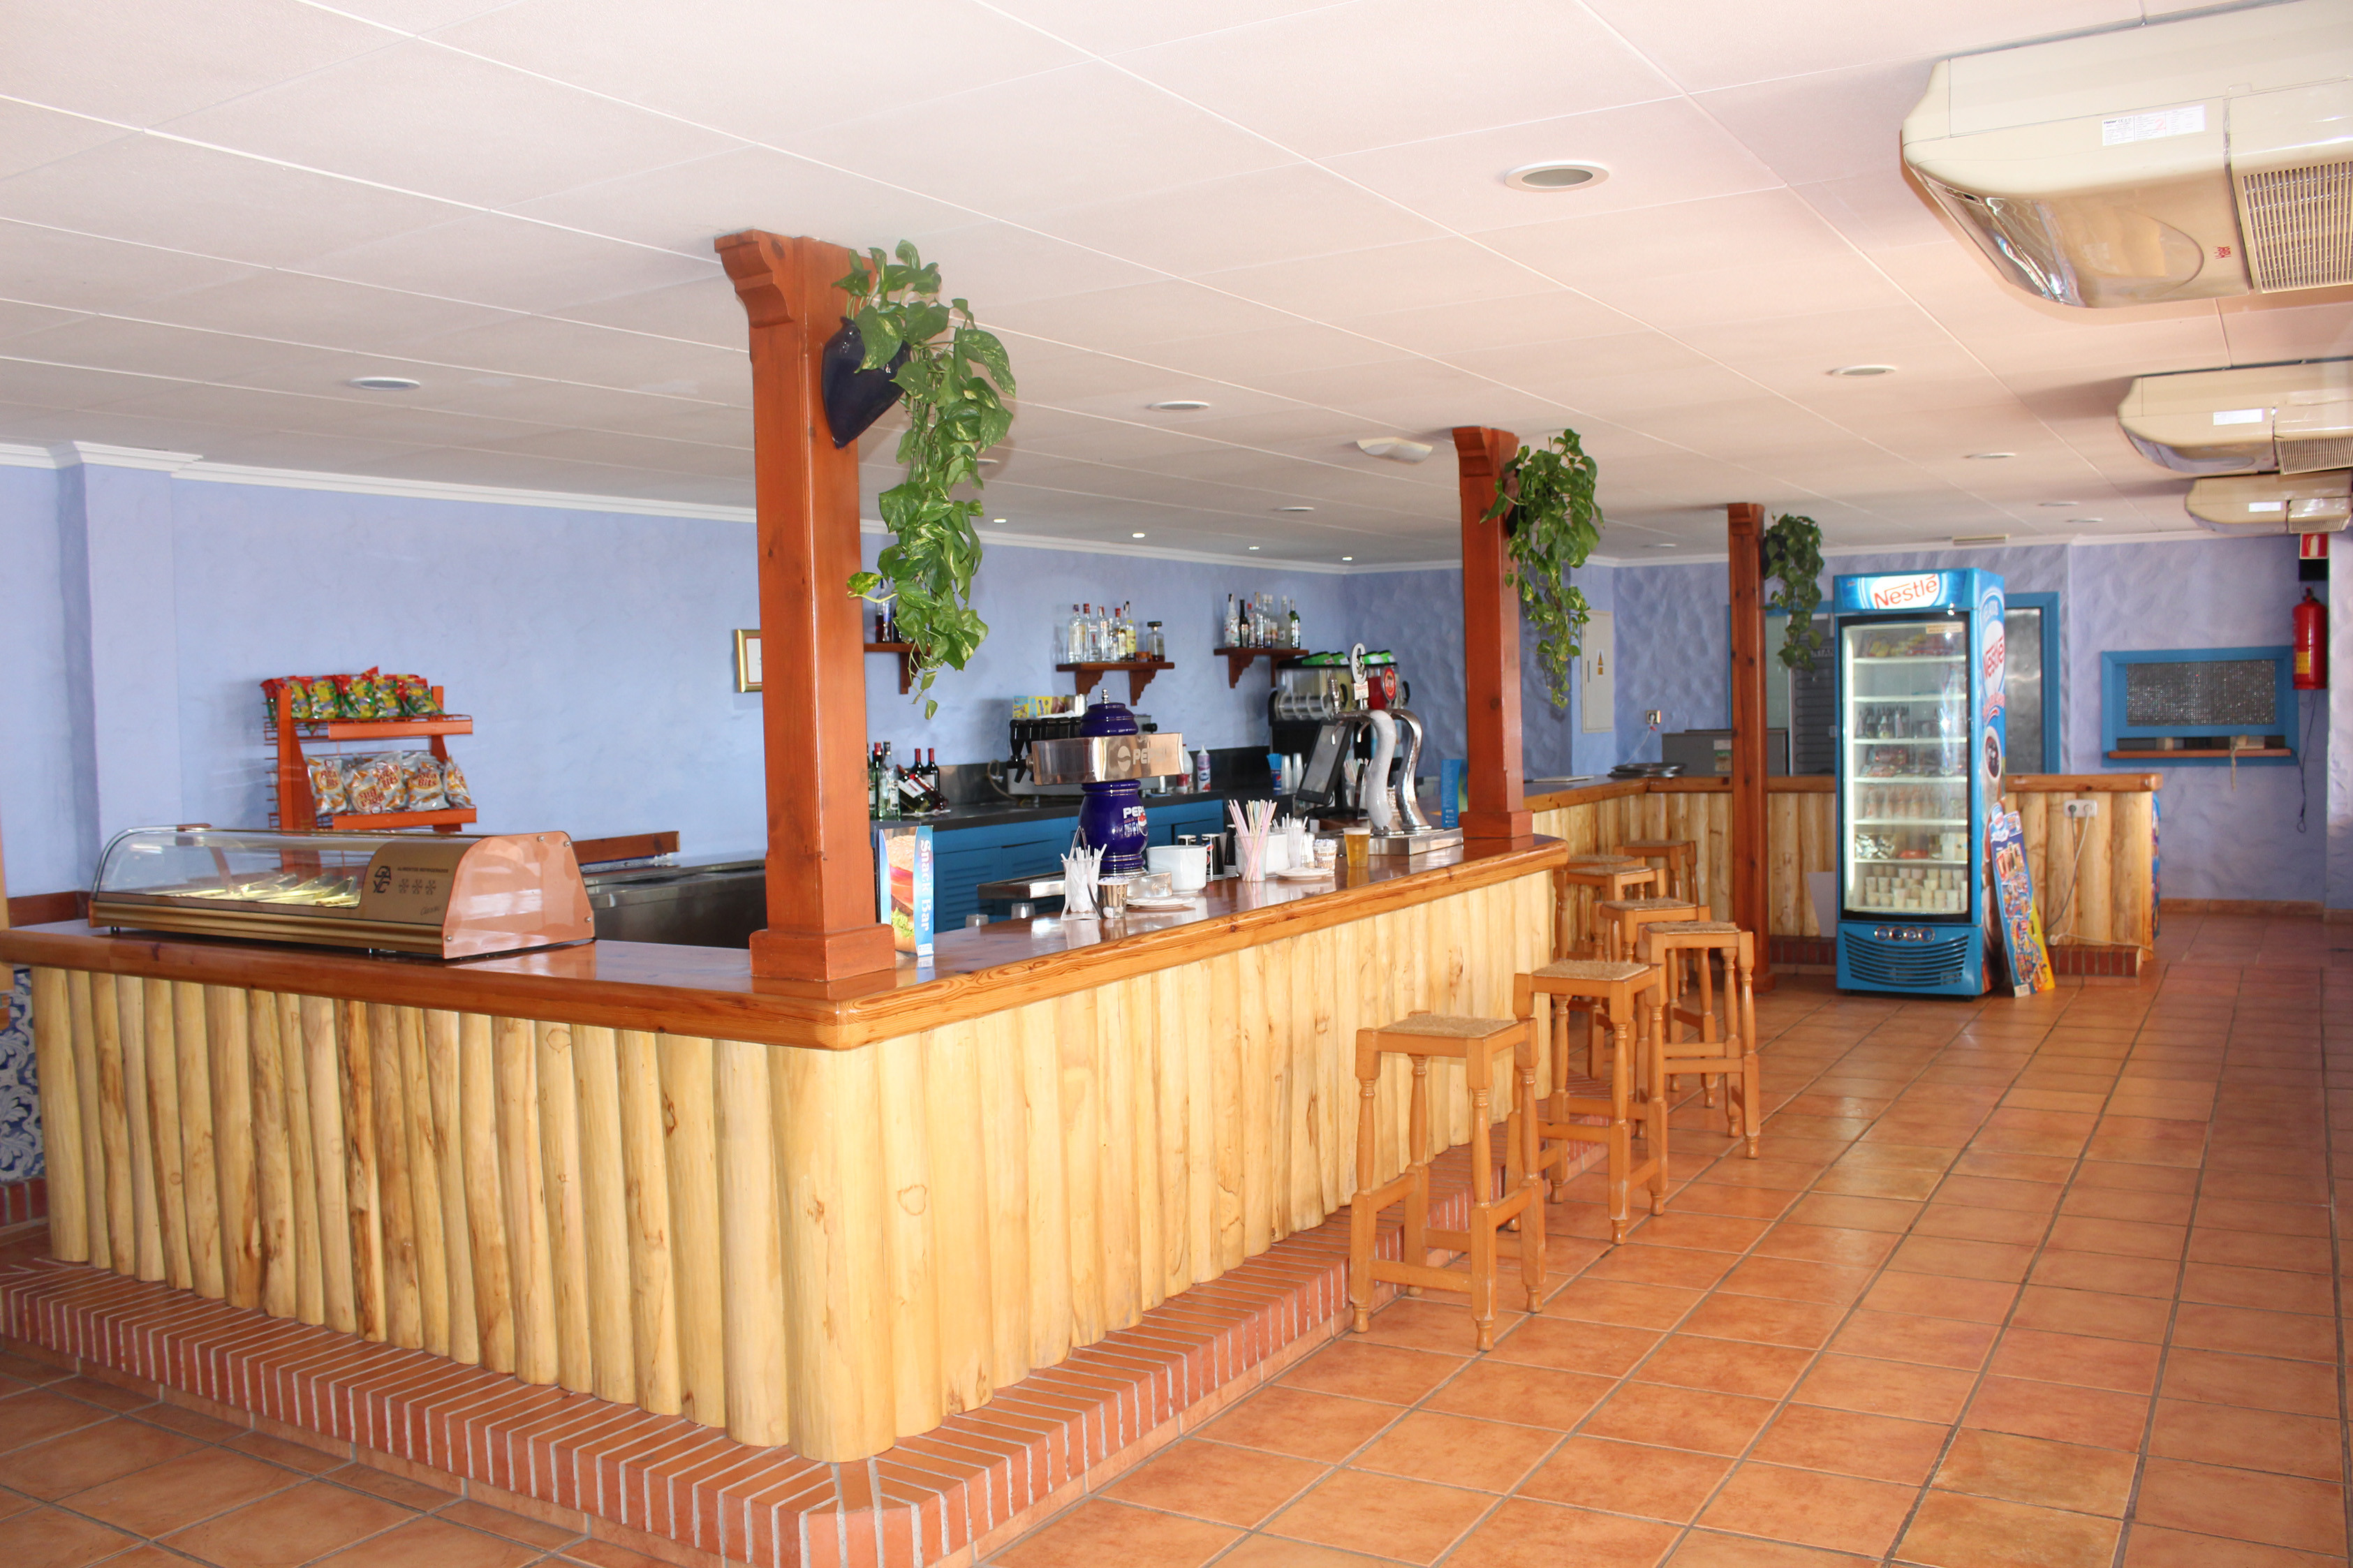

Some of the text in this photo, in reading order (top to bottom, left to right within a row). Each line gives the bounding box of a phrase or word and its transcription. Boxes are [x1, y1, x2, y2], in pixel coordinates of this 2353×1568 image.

[1874, 574, 1938, 609] Nestlé
[920, 839, 931, 894] Snack
[920, 898, 932, 931] Bar
